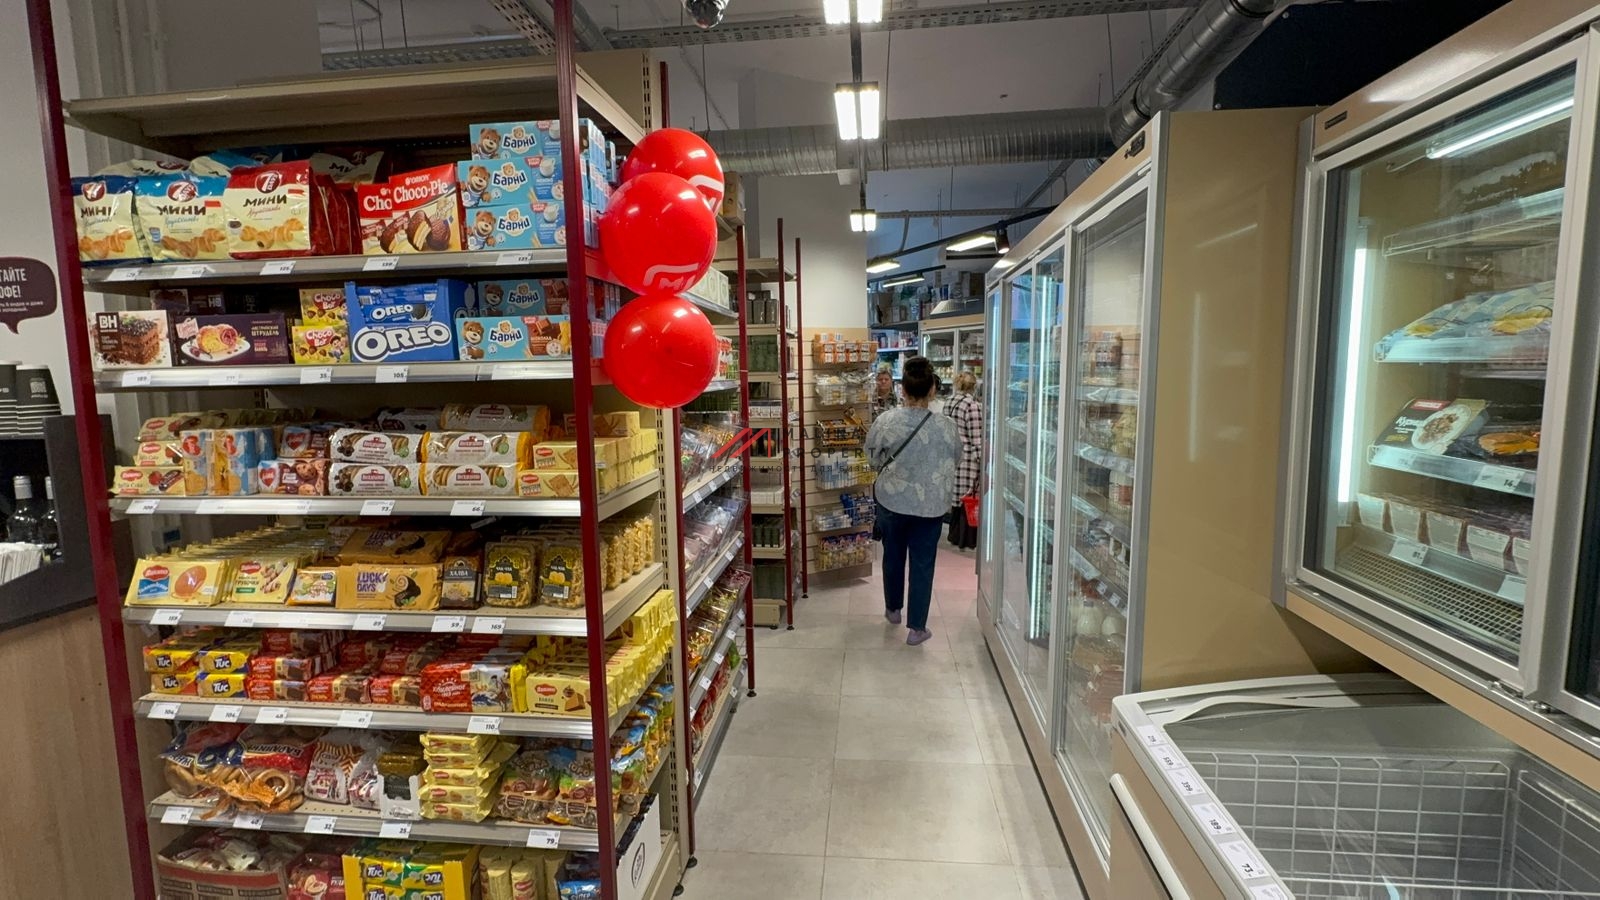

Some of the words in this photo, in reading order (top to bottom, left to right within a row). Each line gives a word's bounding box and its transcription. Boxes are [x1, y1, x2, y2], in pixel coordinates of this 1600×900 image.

[503, 135, 536, 149] Барни
[493, 173, 527, 186] Барни
[393, 179, 448, 203] Choco-Pie
[498, 218, 531, 231] Барни
[509, 292, 539, 303] Барни
[371, 304, 414, 320] OREO
[306, 329, 333, 340] Choco
[354, 322, 451, 359] OREO
[489, 329, 522, 342] Барни
[357, 571, 389, 583] LUCKY
[356, 583, 377, 593] DAYS
[1241, 862, 1254, 874] 73
